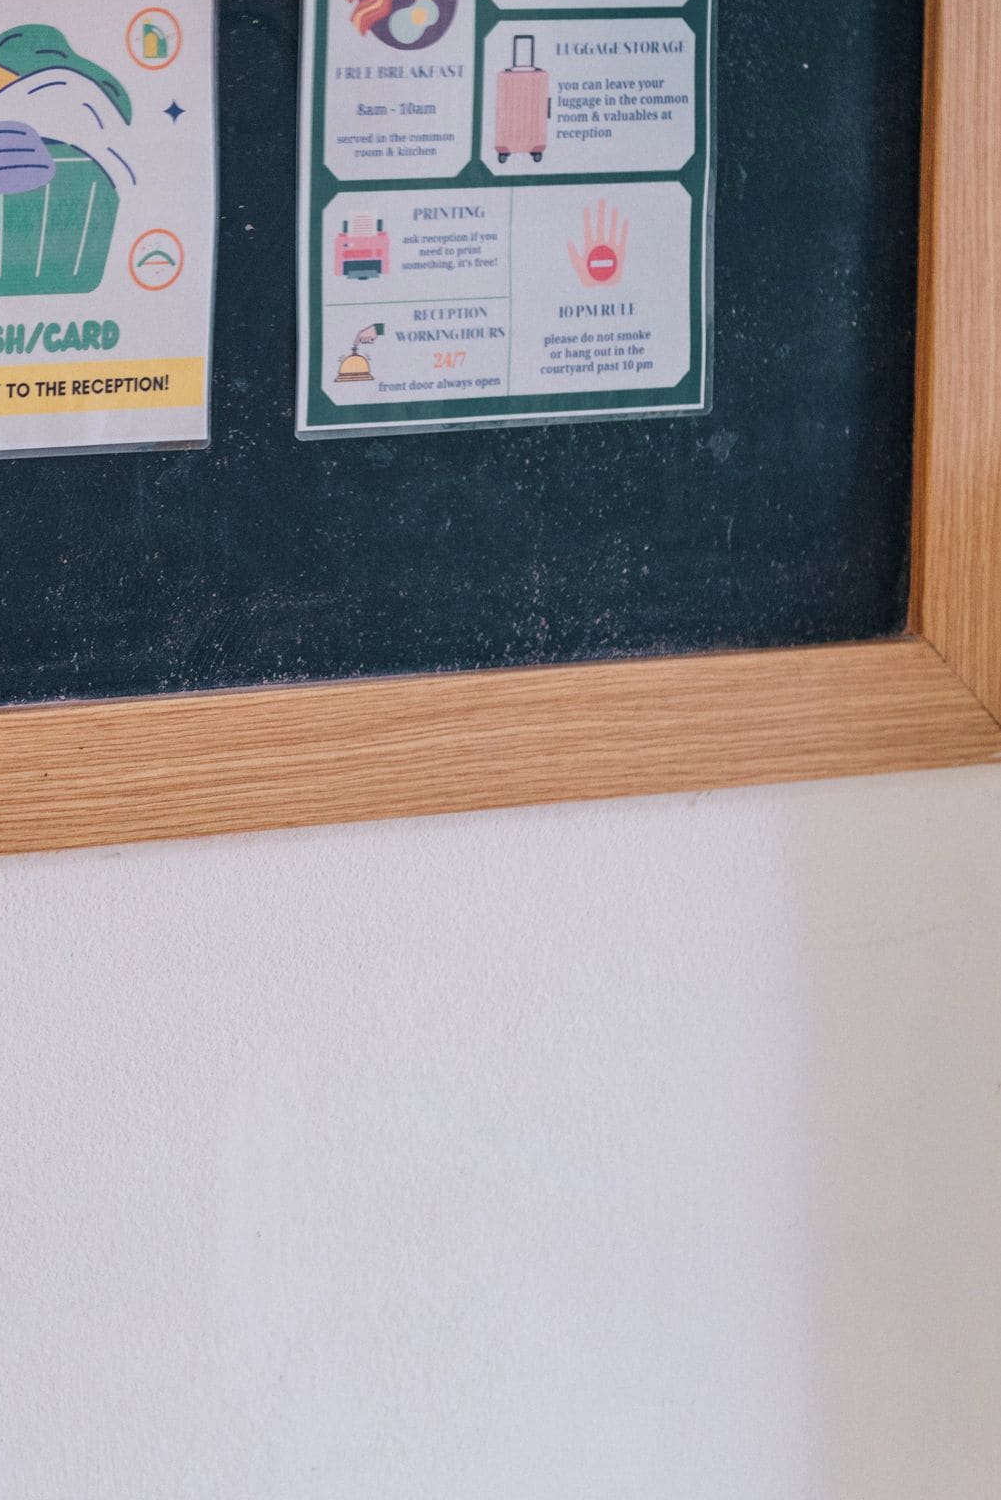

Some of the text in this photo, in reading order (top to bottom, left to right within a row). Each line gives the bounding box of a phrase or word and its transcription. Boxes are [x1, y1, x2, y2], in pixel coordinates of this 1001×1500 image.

[556, 41, 686, 56] LUGGAGE STORAGE
[336, 65, 464, 79] FREE BREAKFAST
[558, 78, 664, 93] you can leave your
[558, 94, 689, 109] luggage in the common
[557, 110, 672, 123] room & valuables at
[556, 127, 612, 141] reception
[413, 206, 485, 220] PRINTING
[480, 233, 497, 242] you
[413, 307, 487, 321] RECEPTION
[576, 305, 597, 318] PM
[601, 303, 635, 316] RULE
[395, 327, 505, 341] WORKING HOURS
[544, 330, 651, 347] please do not smoke
[433, 350, 467, 369] 24/7
[550, 345, 644, 360] or hang out in the
[540, 360, 653, 376] courtyard past 10 pm
[6, 382, 30, 398] TO
[35, 380, 66, 397] THE
[71, 374, 169, 395] RECEPTION!
[408, 380, 434, 390] door
[436, 379, 472, 390] always
[475, 377, 500, 388] open
